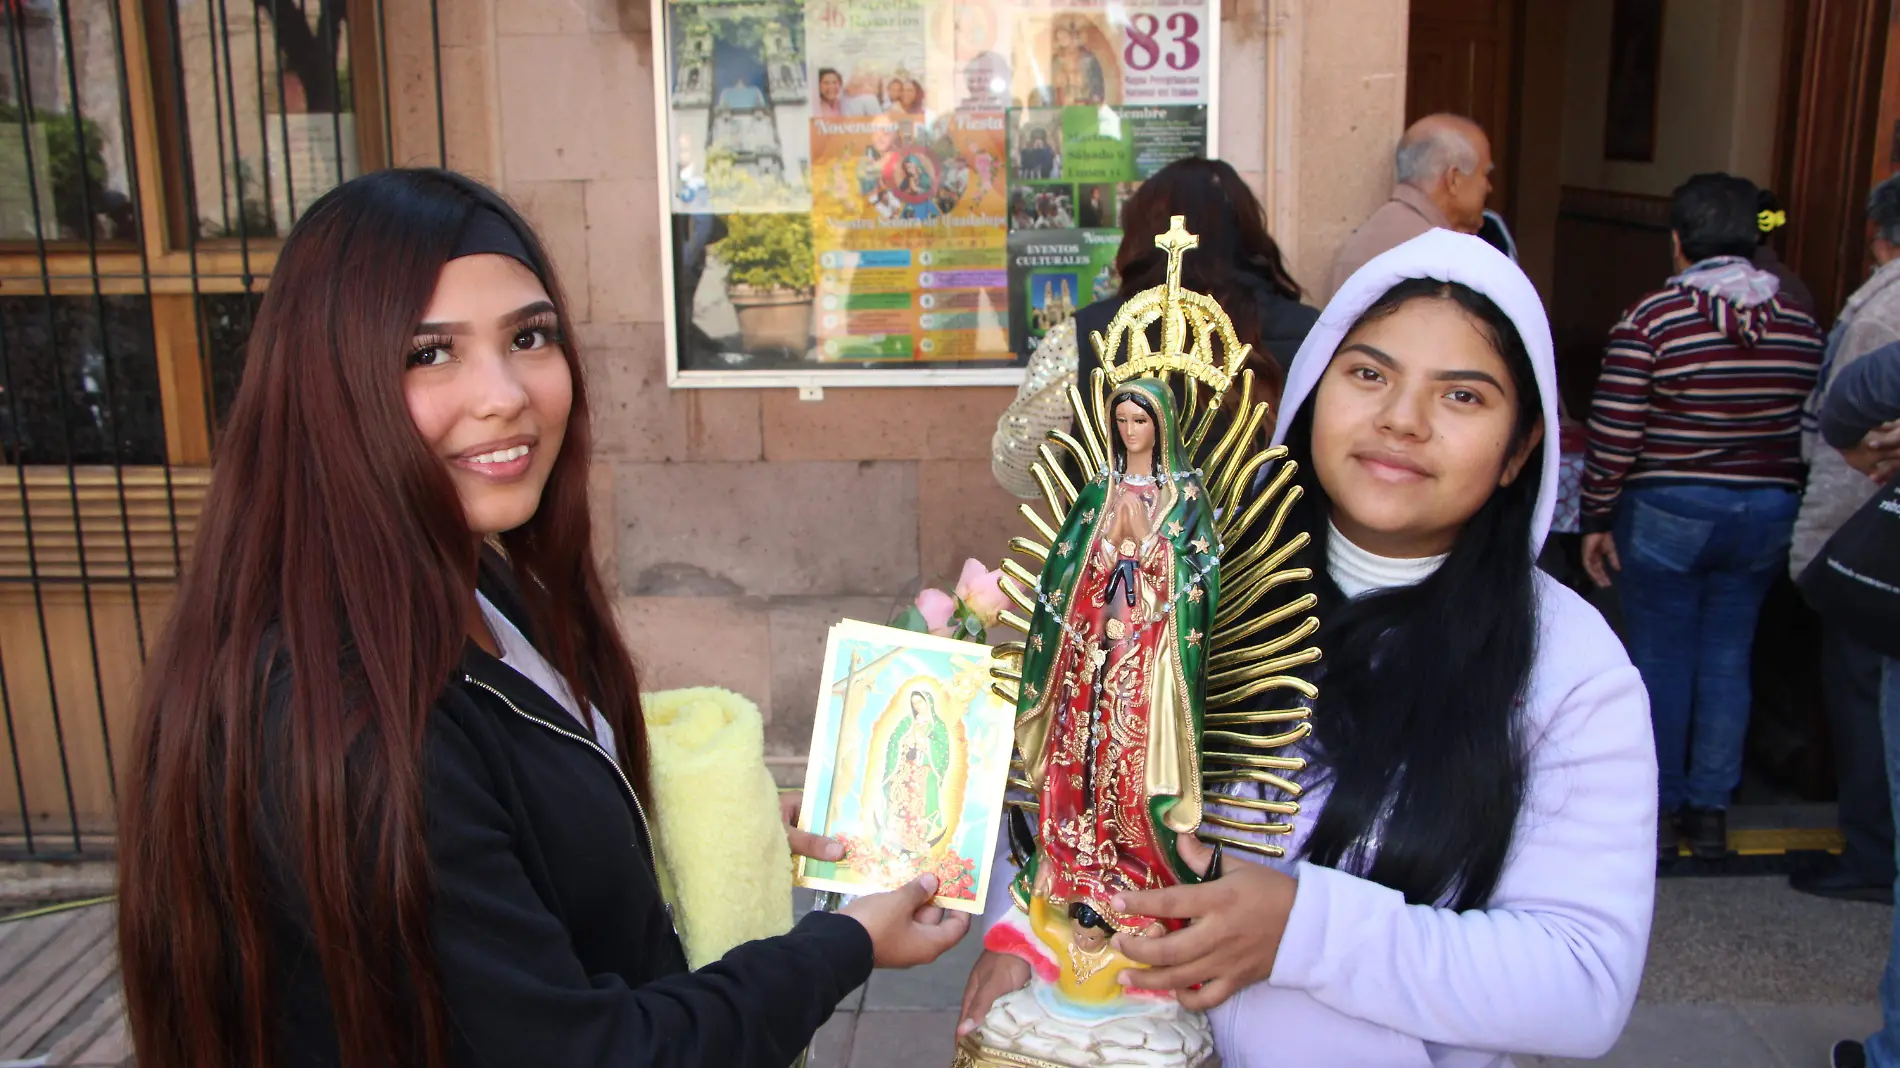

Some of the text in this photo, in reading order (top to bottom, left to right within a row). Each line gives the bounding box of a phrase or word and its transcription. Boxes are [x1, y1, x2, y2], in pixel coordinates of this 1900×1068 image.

[1124, 11, 1200, 71] 83
[957, 115, 1004, 131] Fiesta
[1027, 244, 1079, 254] EVENTOS
[1016, 255, 1090, 266] CULTURALES
